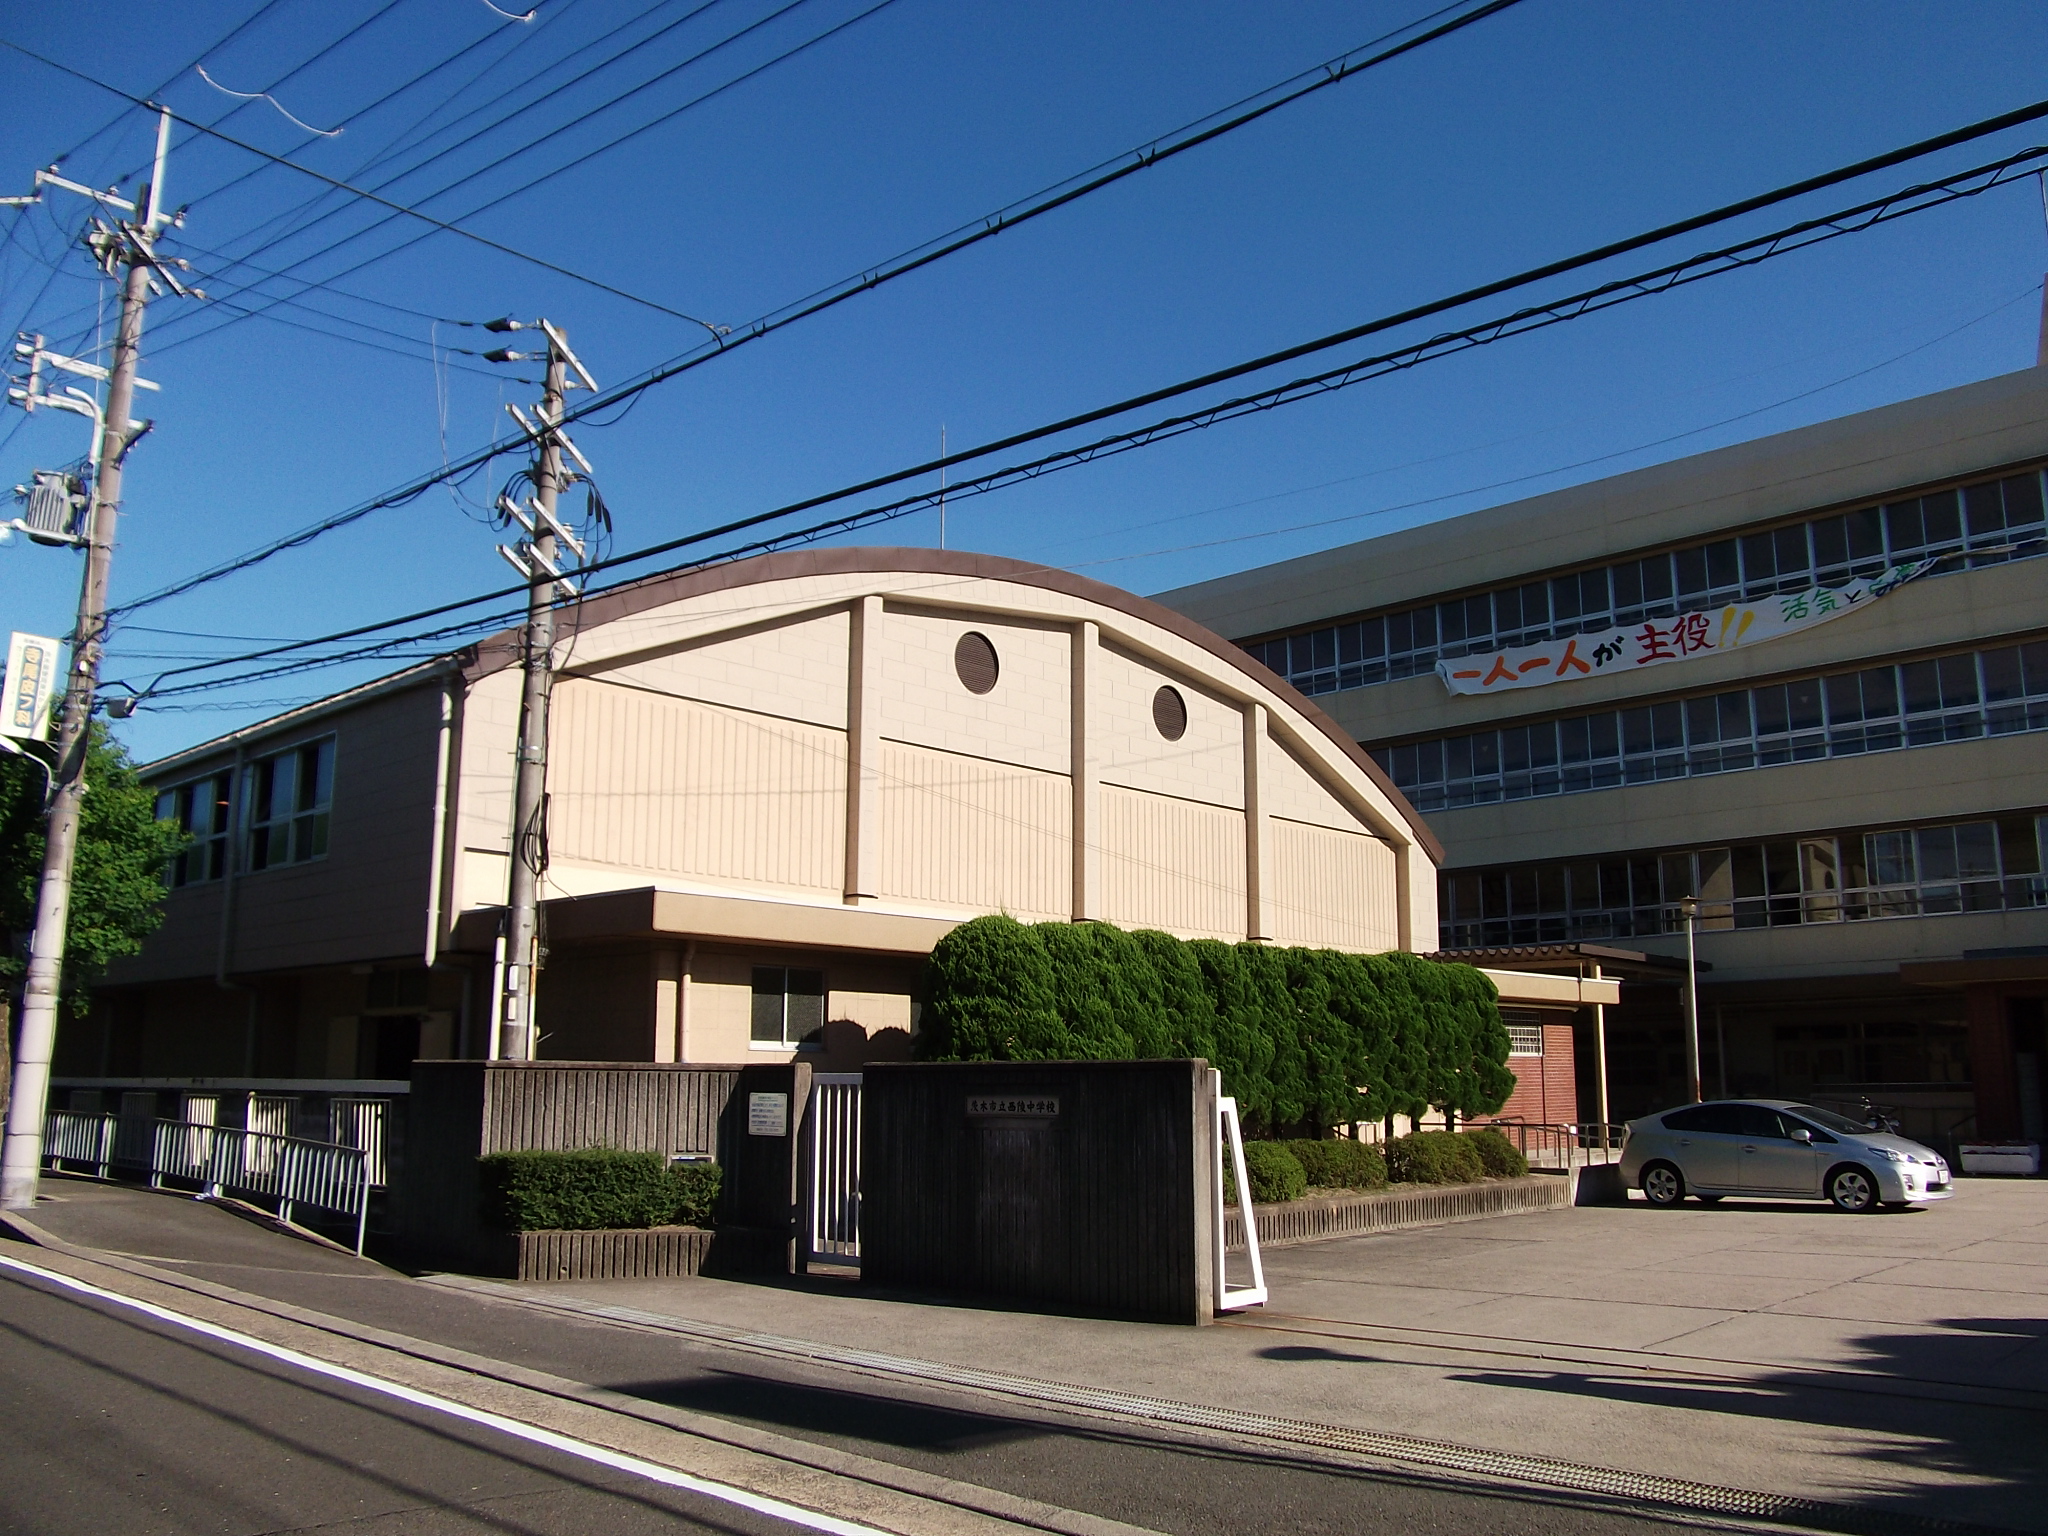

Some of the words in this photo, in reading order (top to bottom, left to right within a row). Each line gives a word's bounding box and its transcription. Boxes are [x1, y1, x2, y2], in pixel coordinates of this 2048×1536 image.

[970, 1100, 1056, 1114] 茨木市立西陵中学校
